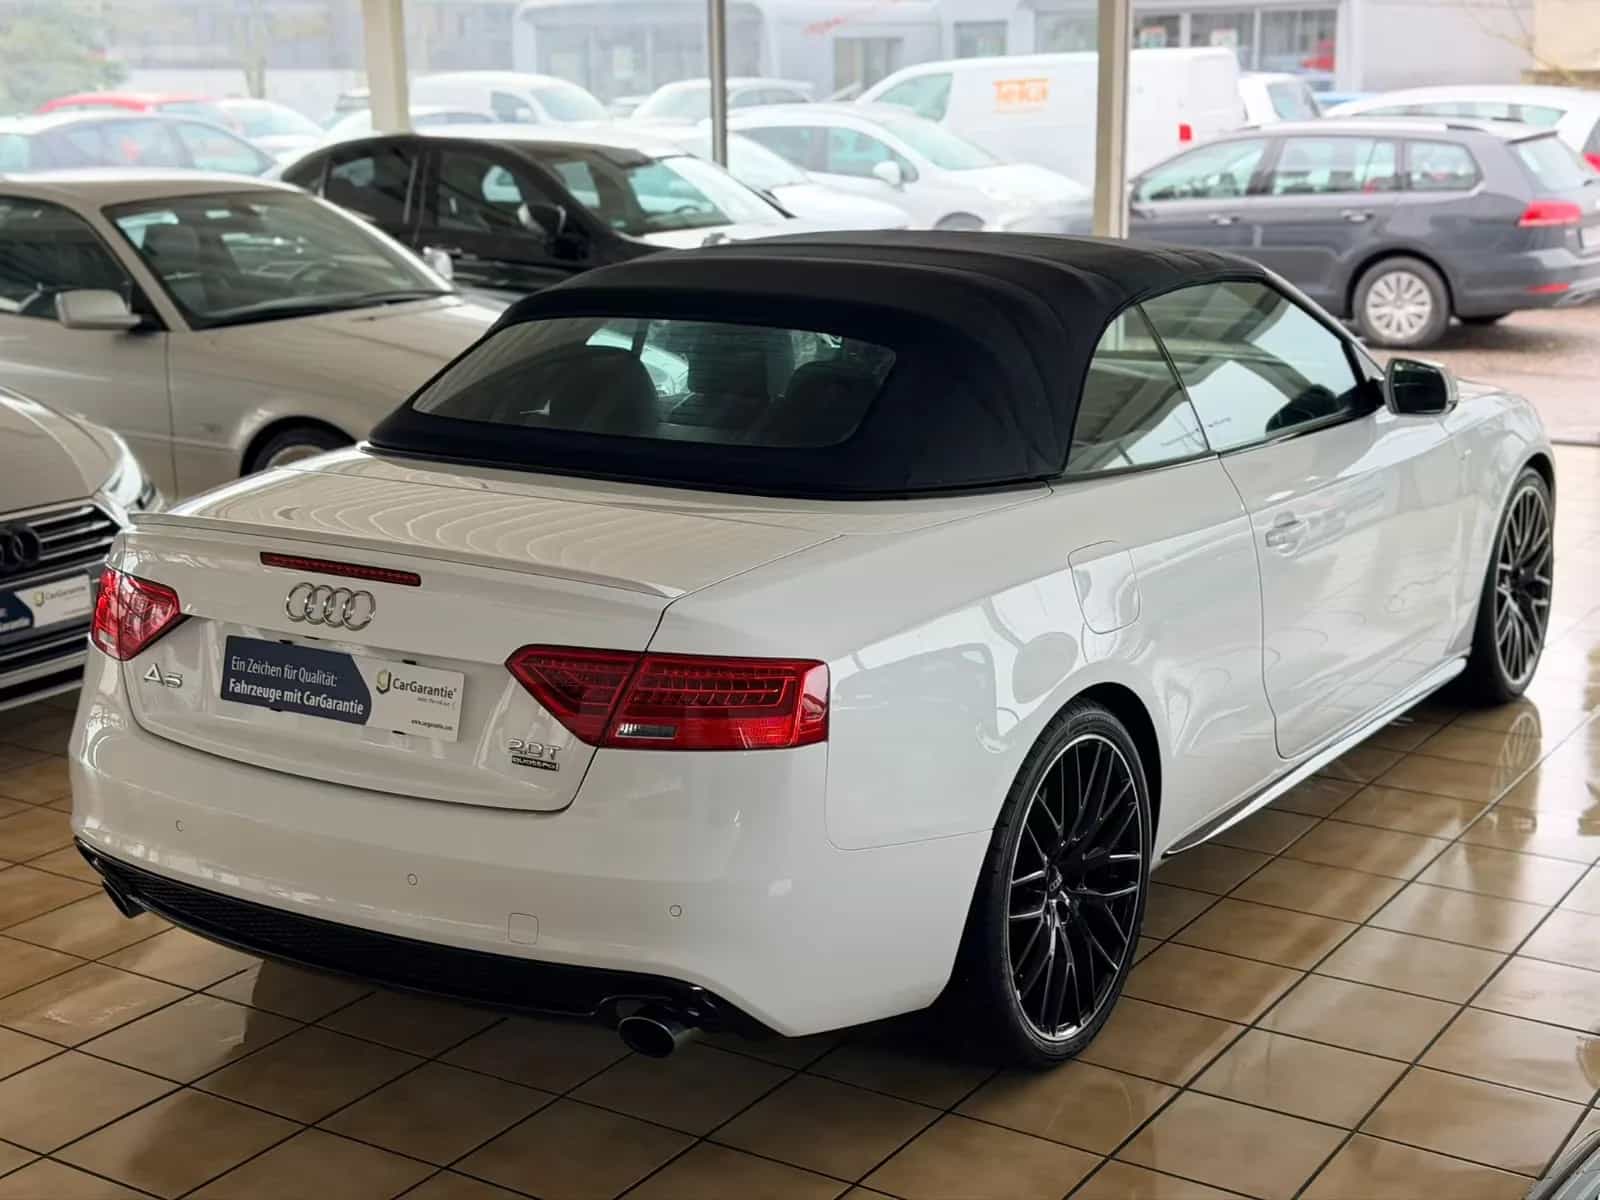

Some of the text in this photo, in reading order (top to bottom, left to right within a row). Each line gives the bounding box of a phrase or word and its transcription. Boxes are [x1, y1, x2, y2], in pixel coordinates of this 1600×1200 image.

[144, 663, 183, 688] A5
[231, 655, 338, 688] Ein Zeichen für Qualität:
[229, 677, 364, 715] Fahrzeuge mit CarGarantie
